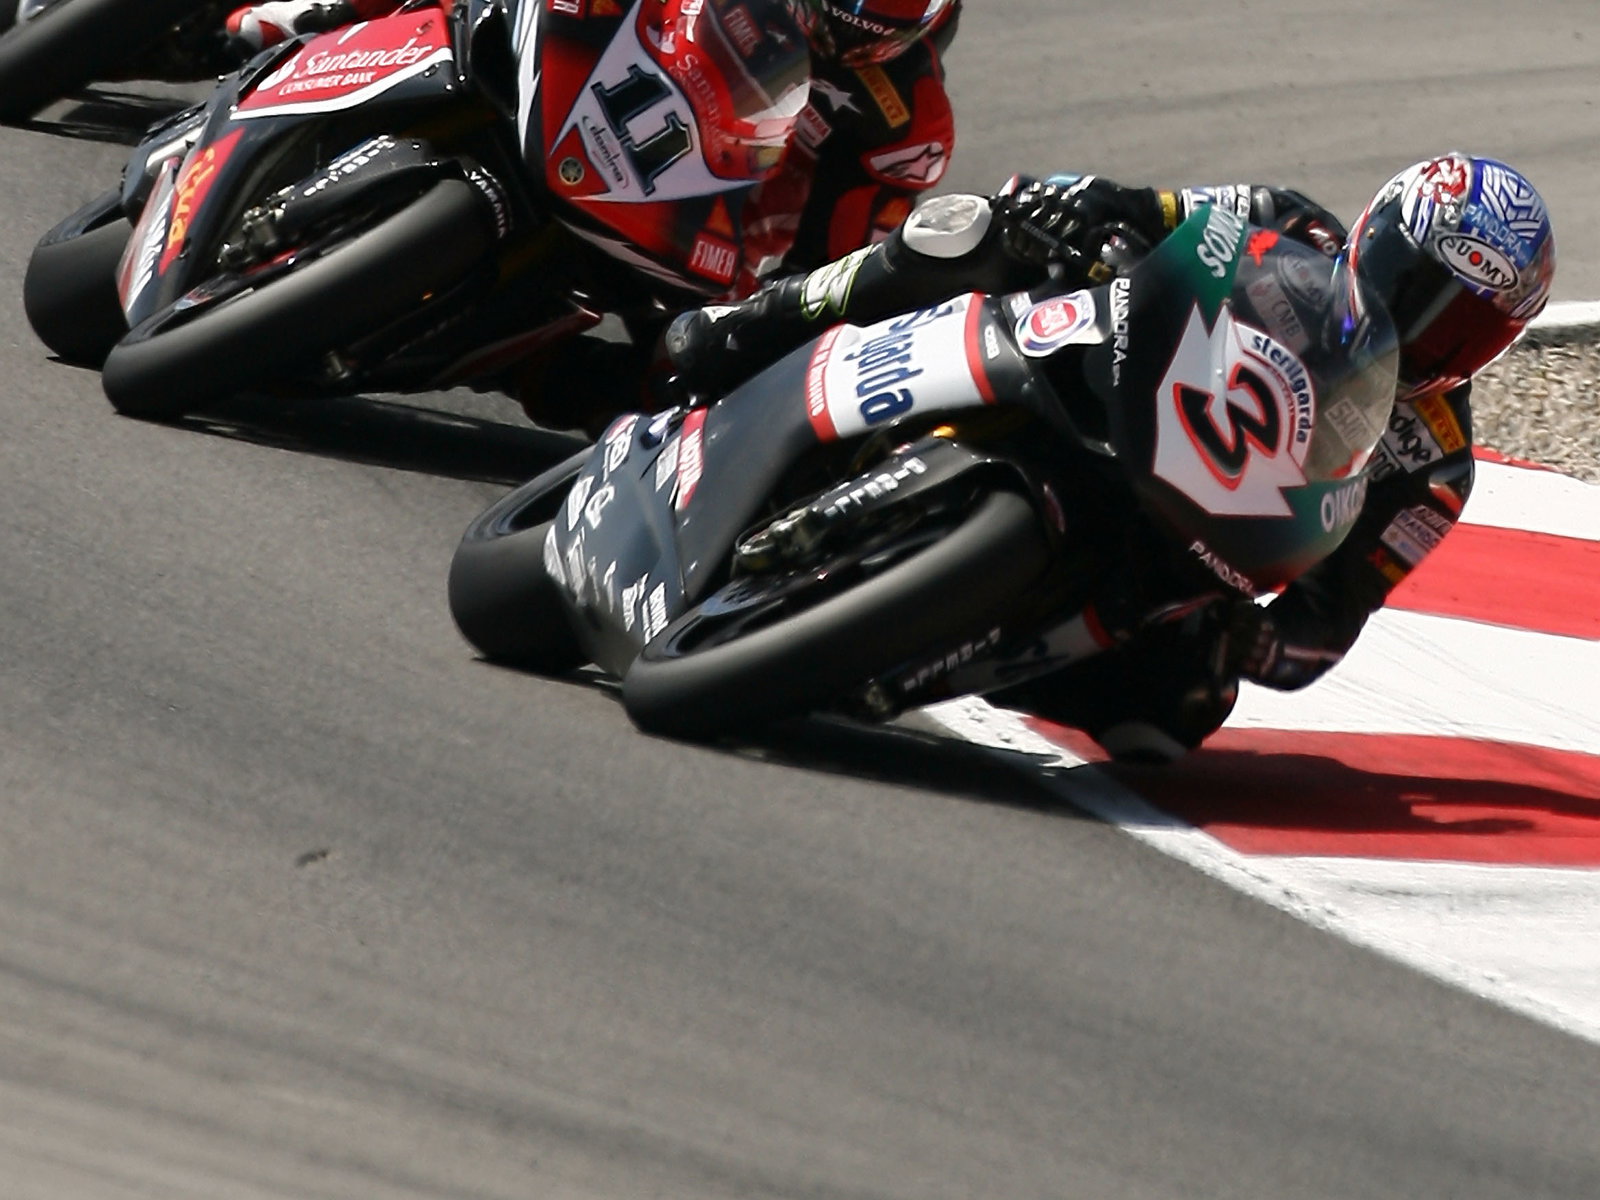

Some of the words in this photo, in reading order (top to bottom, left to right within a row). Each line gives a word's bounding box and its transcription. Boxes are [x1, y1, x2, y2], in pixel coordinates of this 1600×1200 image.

[831, 4, 884, 34] VOLVO
[293, 37, 433, 79] Santander
[591, 63, 693, 197] 11
[692, 240, 737, 278] FIMER
[1445, 237, 1511, 288] SUOMY
[1112, 278, 1130, 364] PANDORA
[1253, 334, 1313, 444] sterilgarda
[1173, 362, 1280, 492] 3
